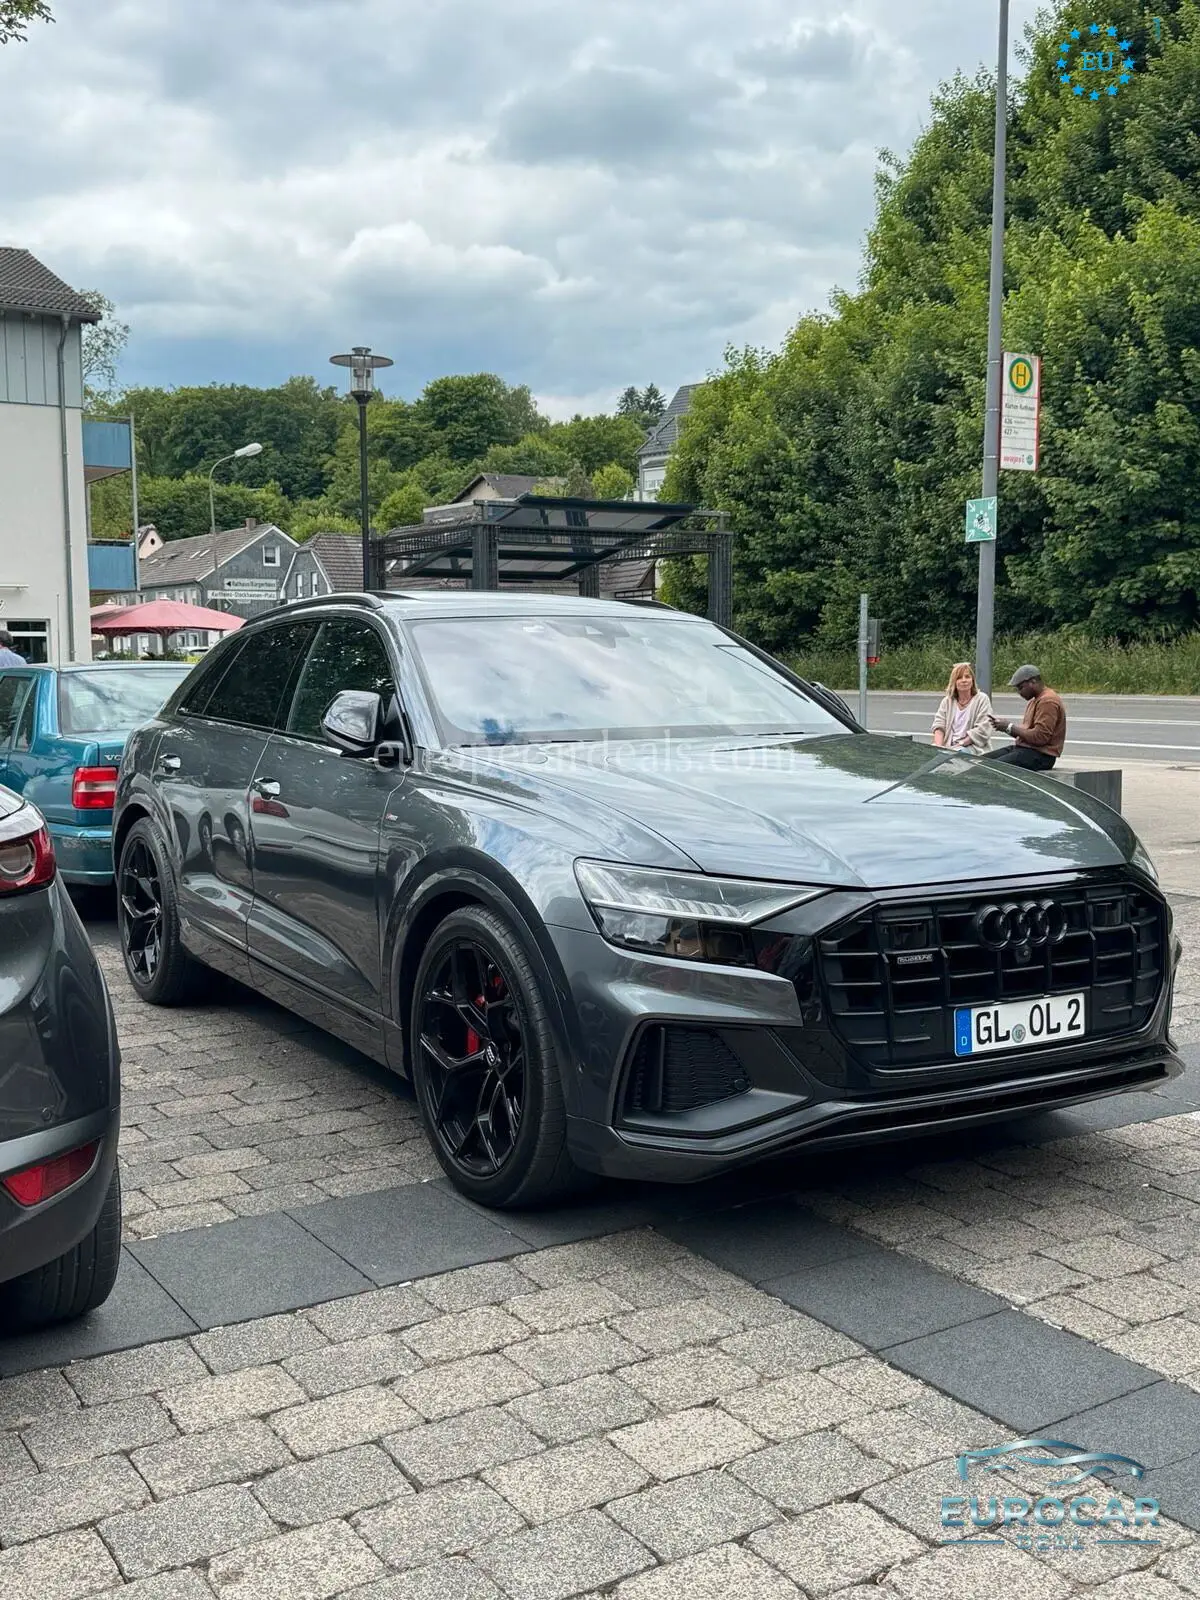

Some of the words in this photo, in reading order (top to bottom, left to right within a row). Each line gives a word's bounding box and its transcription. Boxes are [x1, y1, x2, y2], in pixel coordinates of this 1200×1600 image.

[1016, 366, 1027, 386] H
[975, 1010, 1011, 1045] GL
[1029, 1002, 1061, 1037] OL
[1067, 998, 1081, 1032] 2
[961, 1036, 968, 1046] D
